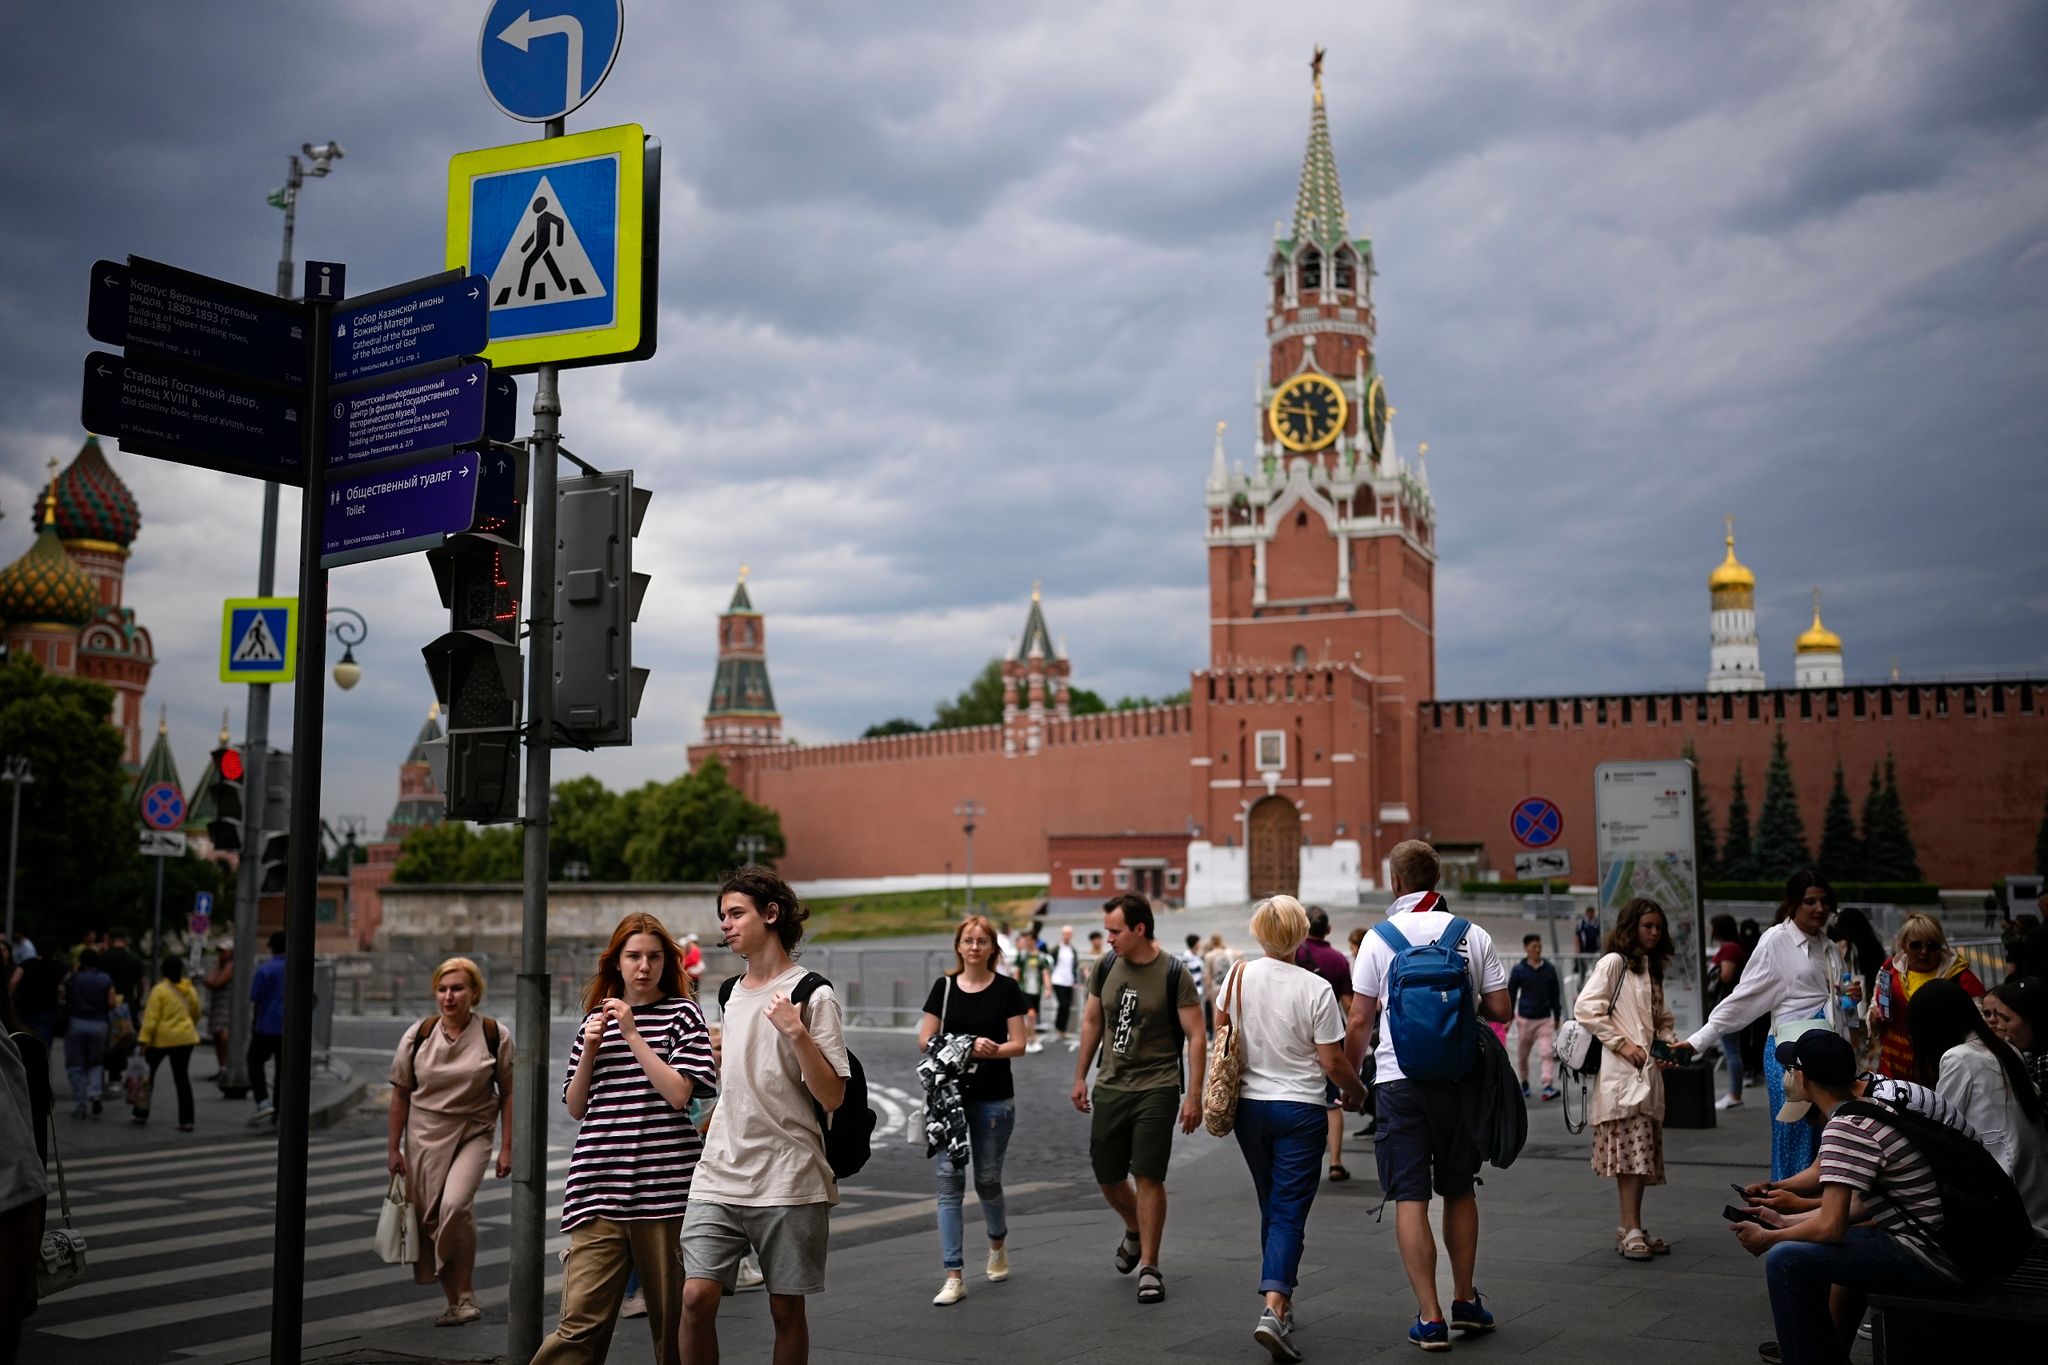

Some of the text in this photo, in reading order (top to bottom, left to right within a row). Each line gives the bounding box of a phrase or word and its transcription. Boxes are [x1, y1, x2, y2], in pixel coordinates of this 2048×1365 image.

[129, 293, 231, 327] рядов, 1889-1893 гг.
[130, 279, 258, 321] Корпус Верхних торговых
[354, 296, 444, 326] Собор Казанской иконы
[128, 316, 171, 333] 1889-1893
[129, 305, 248, 344] Building of Upper trading rows,
[352, 323, 434, 350] Cathedral of the Kazan icon
[353, 316, 412, 338] Божией Матери
[352, 337, 416, 360] of the Mother of God
[123, 368, 258, 409] Старый Гостиный двор,
[123, 383, 160, 401] конец
[192, 398, 201, 408] в.
[351, 379, 445, 410] Туристский информационный
[122, 396, 136, 407] Old
[139, 399, 169, 415] Gostiny
[171, 407, 191, 420] Dvor,
[193, 412, 208, 422] end
[210, 415, 218, 424] of
[350, 388, 459, 419] центр (в филиале Государственного
[350, 406, 416, 429] Исторического Музея)
[349, 429, 366, 438] Tourist
[367, 422, 396, 435] information
[397, 419, 413, 428] centre
[422, 414, 430, 423] the
[432, 410, 449, 419] branch
[349, 419, 447, 447] building of the State Historical Museum)
[347, 470, 452, 500] Общественный туалет
[346, 504, 365, 516] Toilet
